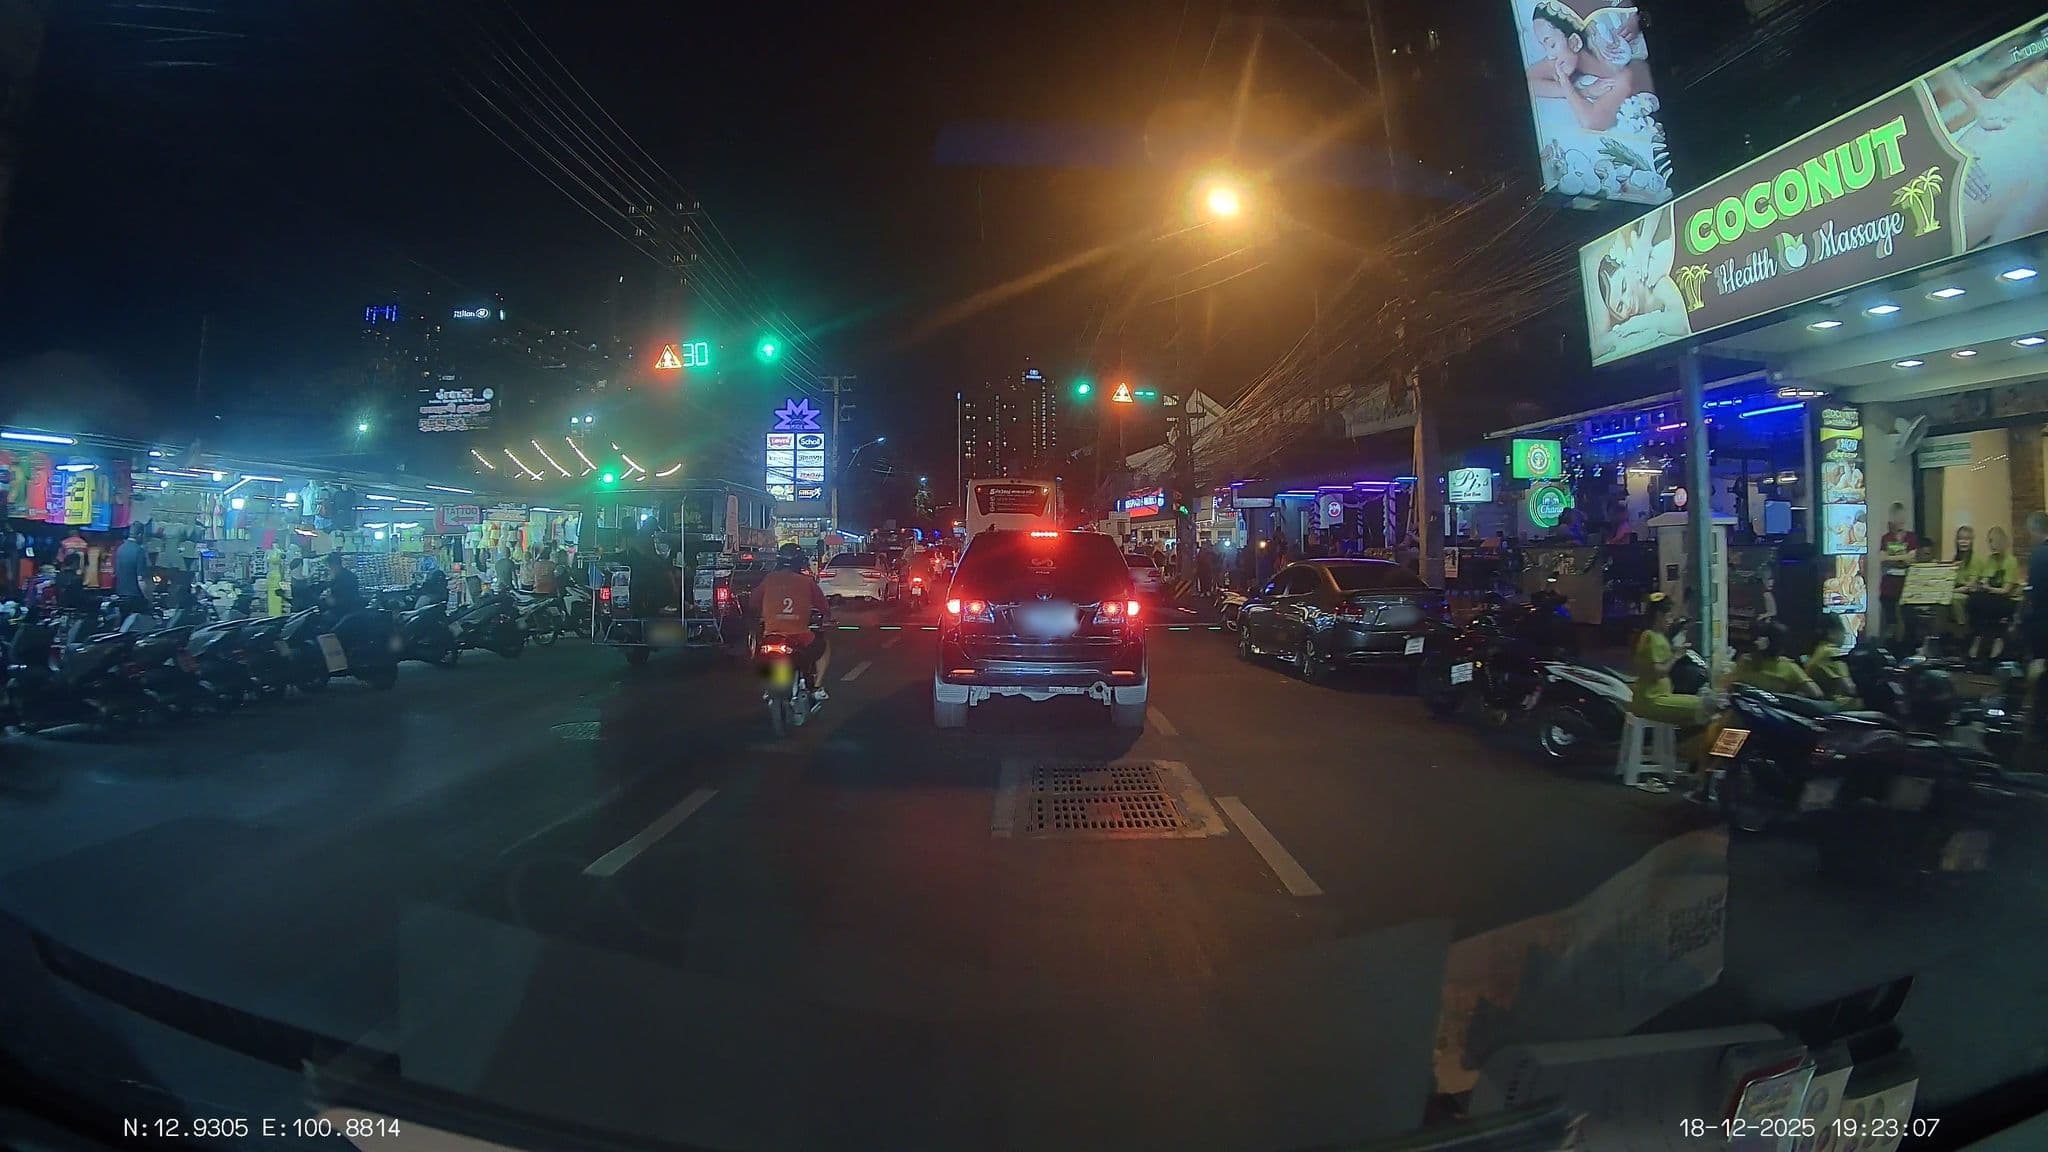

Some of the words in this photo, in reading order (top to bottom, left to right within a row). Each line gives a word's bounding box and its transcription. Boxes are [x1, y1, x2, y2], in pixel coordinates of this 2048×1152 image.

[1687, 115, 1907, 254] COCONUT
[1717, 247, 1778, 294] Health
[1818, 211, 1905, 256] Massage
[682, 342, 708, 367] 30
[800, 438, 820, 446] Scholl
[782, 597, 794, 614] 2
